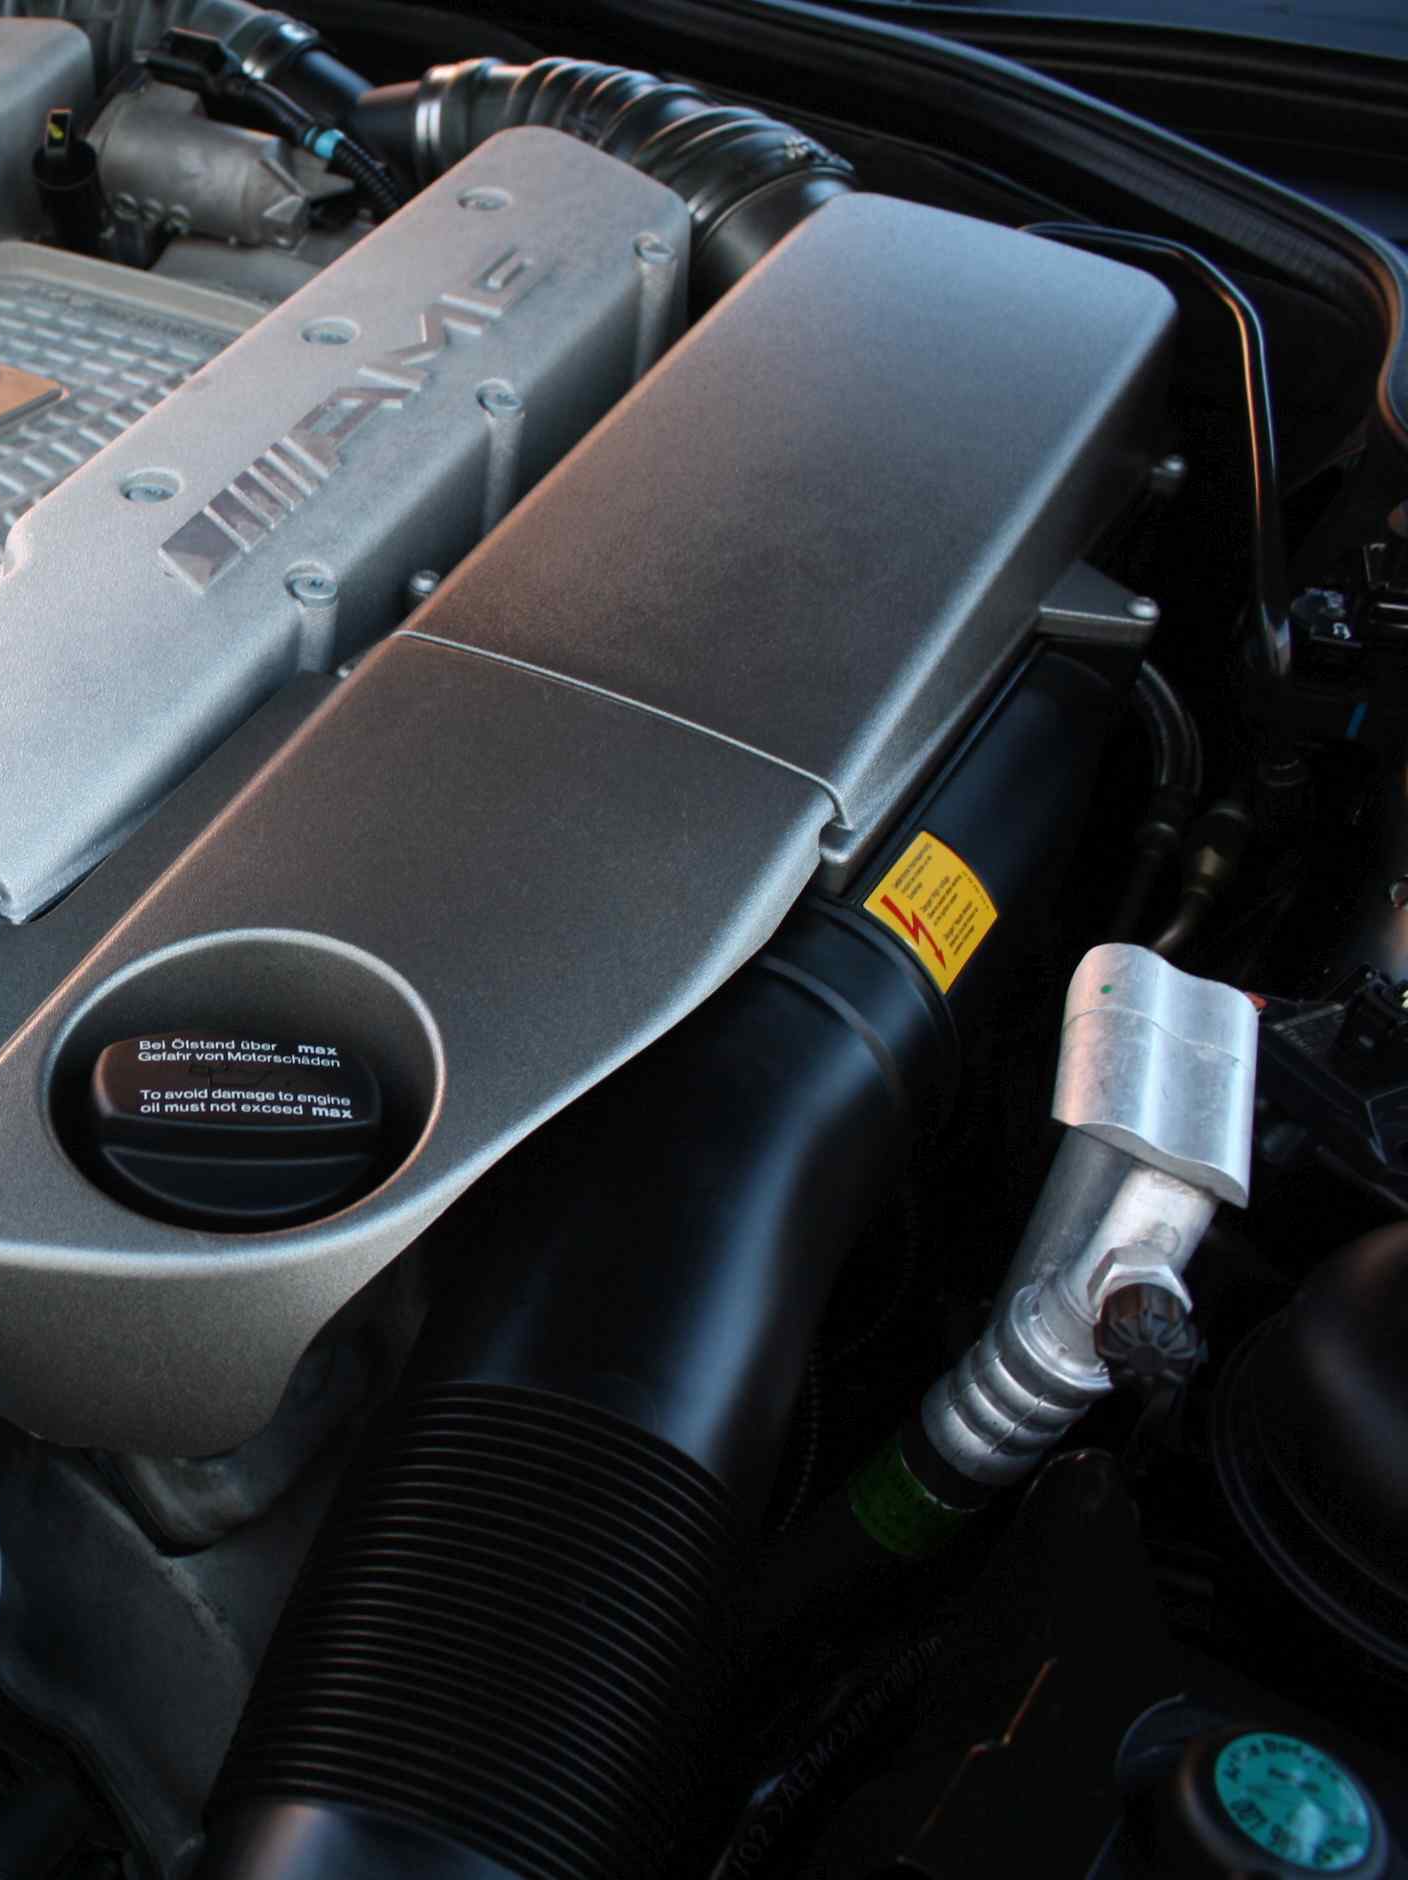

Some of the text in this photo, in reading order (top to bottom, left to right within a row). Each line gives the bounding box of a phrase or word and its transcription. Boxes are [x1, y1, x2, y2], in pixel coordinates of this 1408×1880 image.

[139, 1038, 337, 1056] Bei Ölstand über max
[137, 1051, 340, 1068] Gefahr von Motorschäden
[139, 1088, 351, 1106] To avoid damage to engine
[140, 1101, 353, 1119] oil must not exceed max
